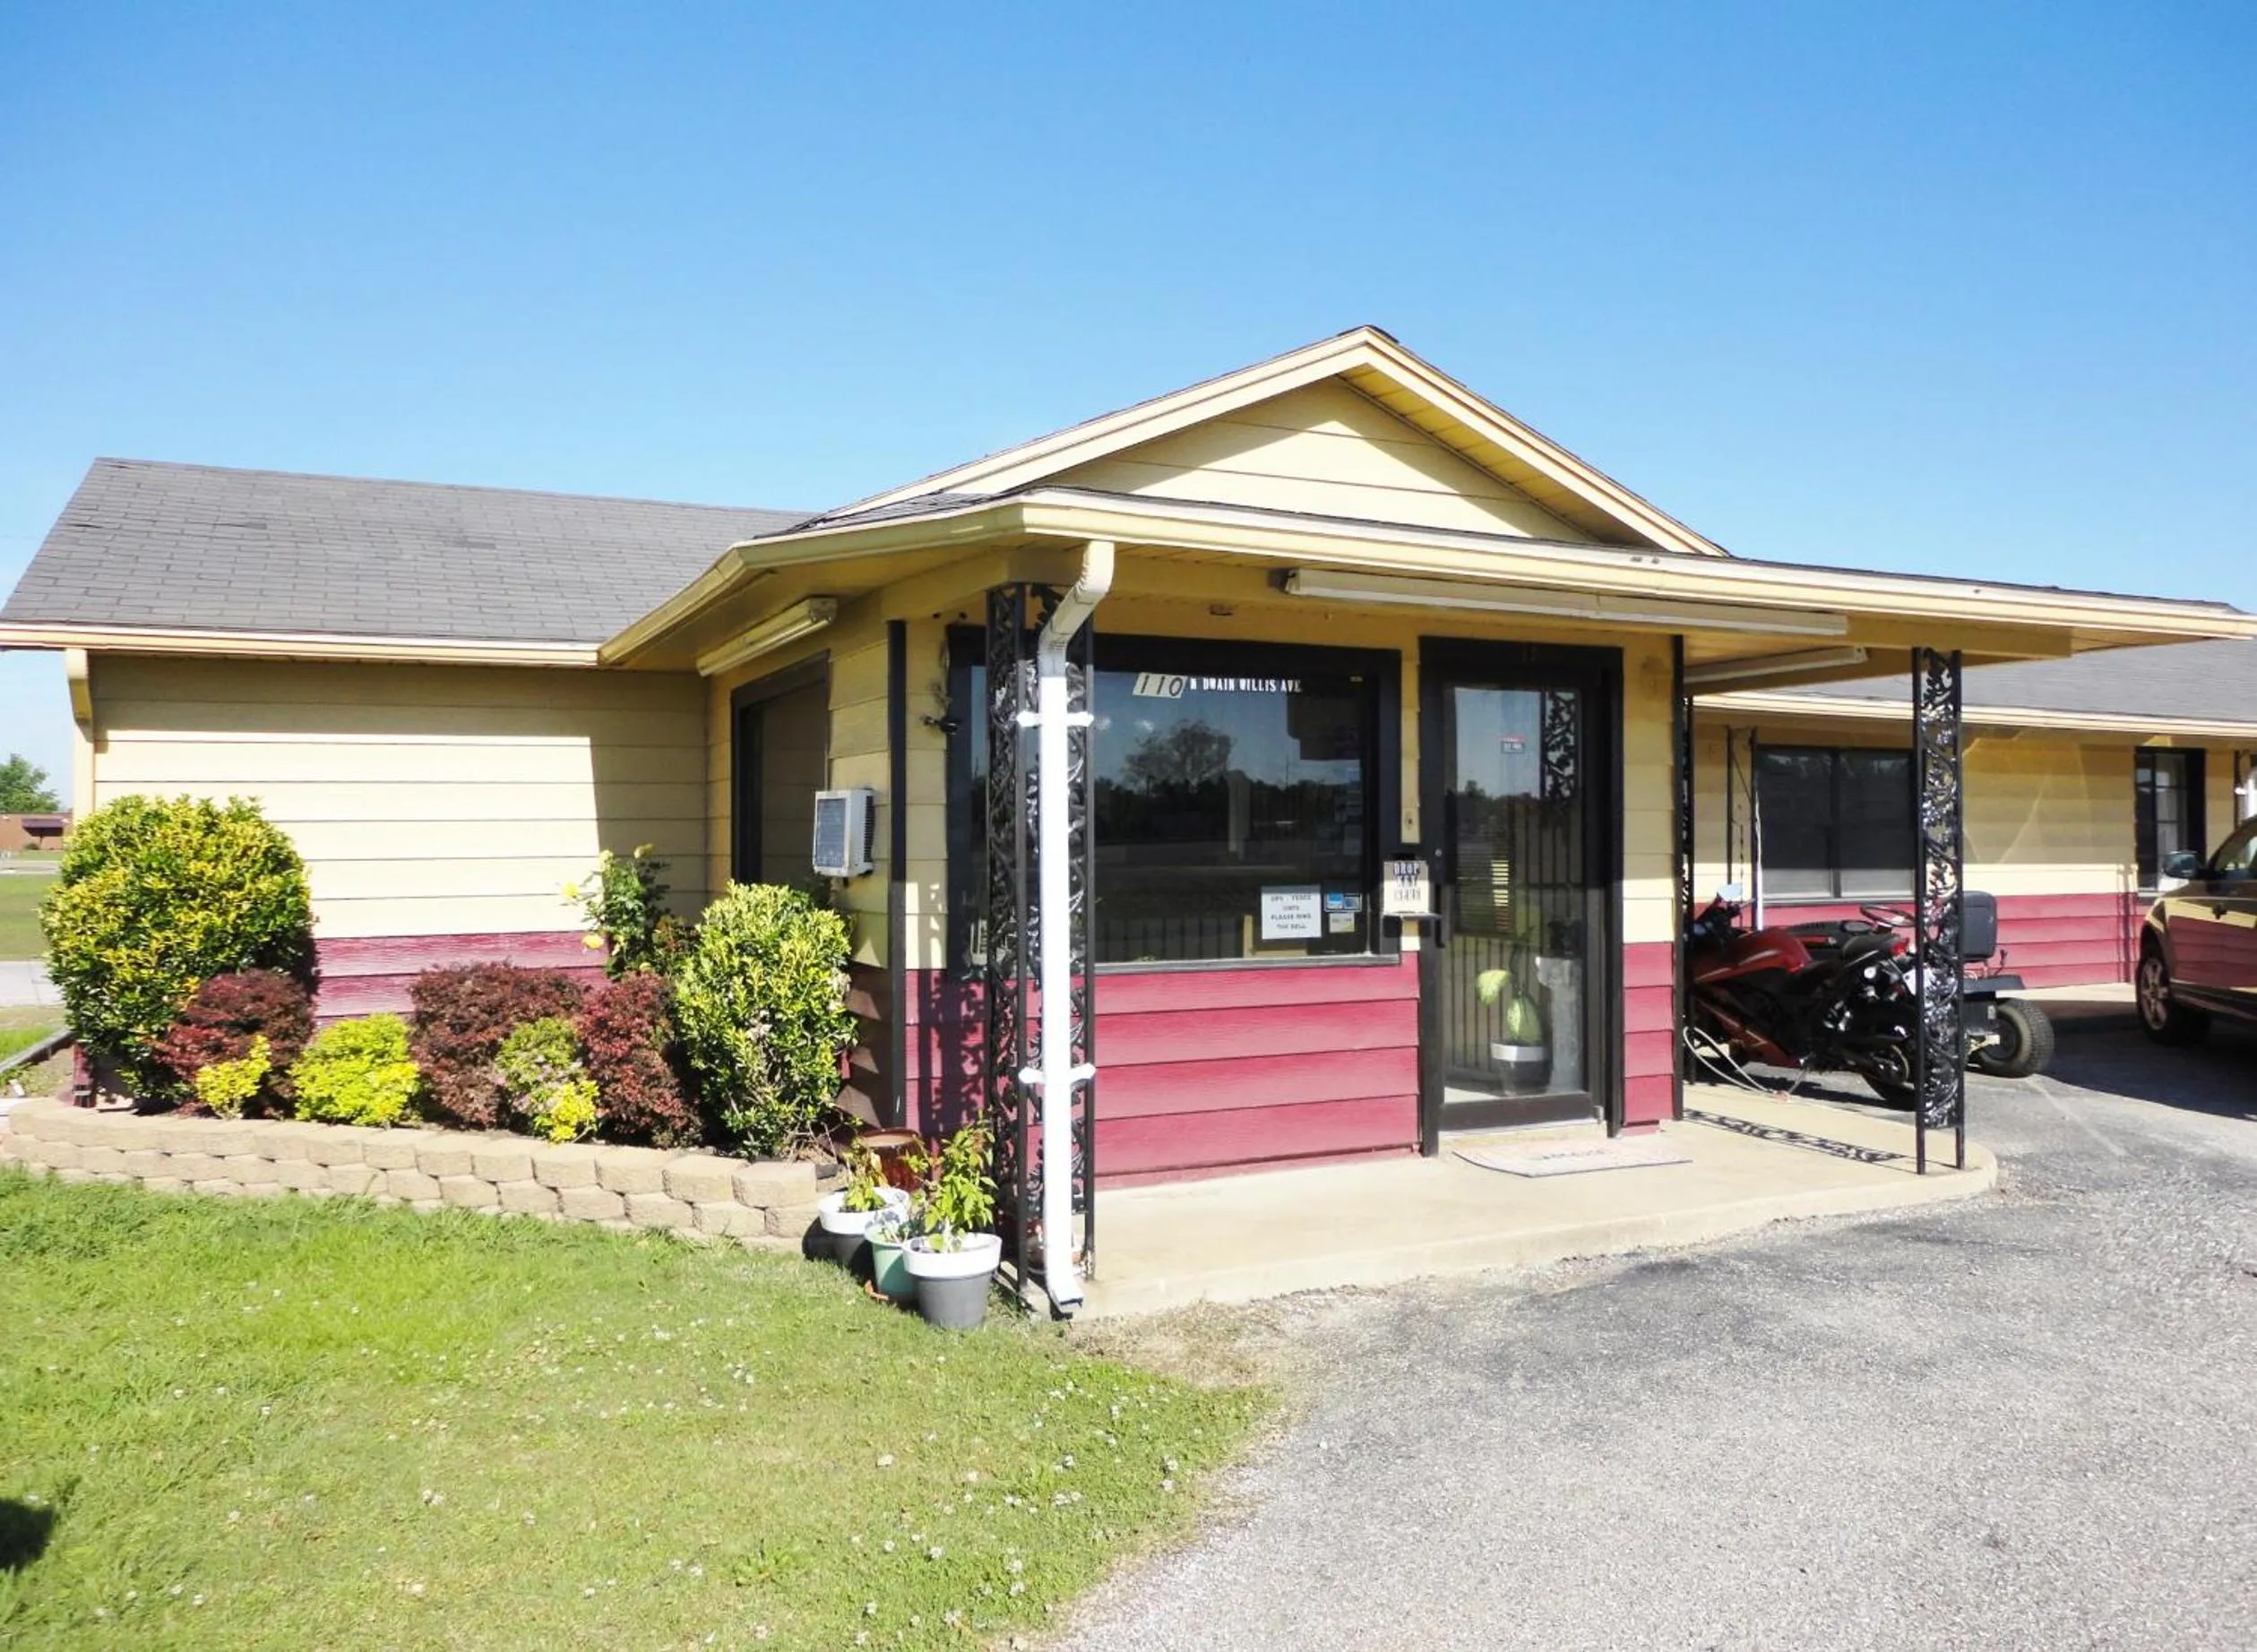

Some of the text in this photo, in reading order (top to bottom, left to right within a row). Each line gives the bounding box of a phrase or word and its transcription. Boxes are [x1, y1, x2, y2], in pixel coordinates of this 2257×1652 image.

[1139, 675, 1184, 697] 110
[1202, 677, 1235, 692] DWAIN
[1239, 677, 1277, 693] WILLIS
